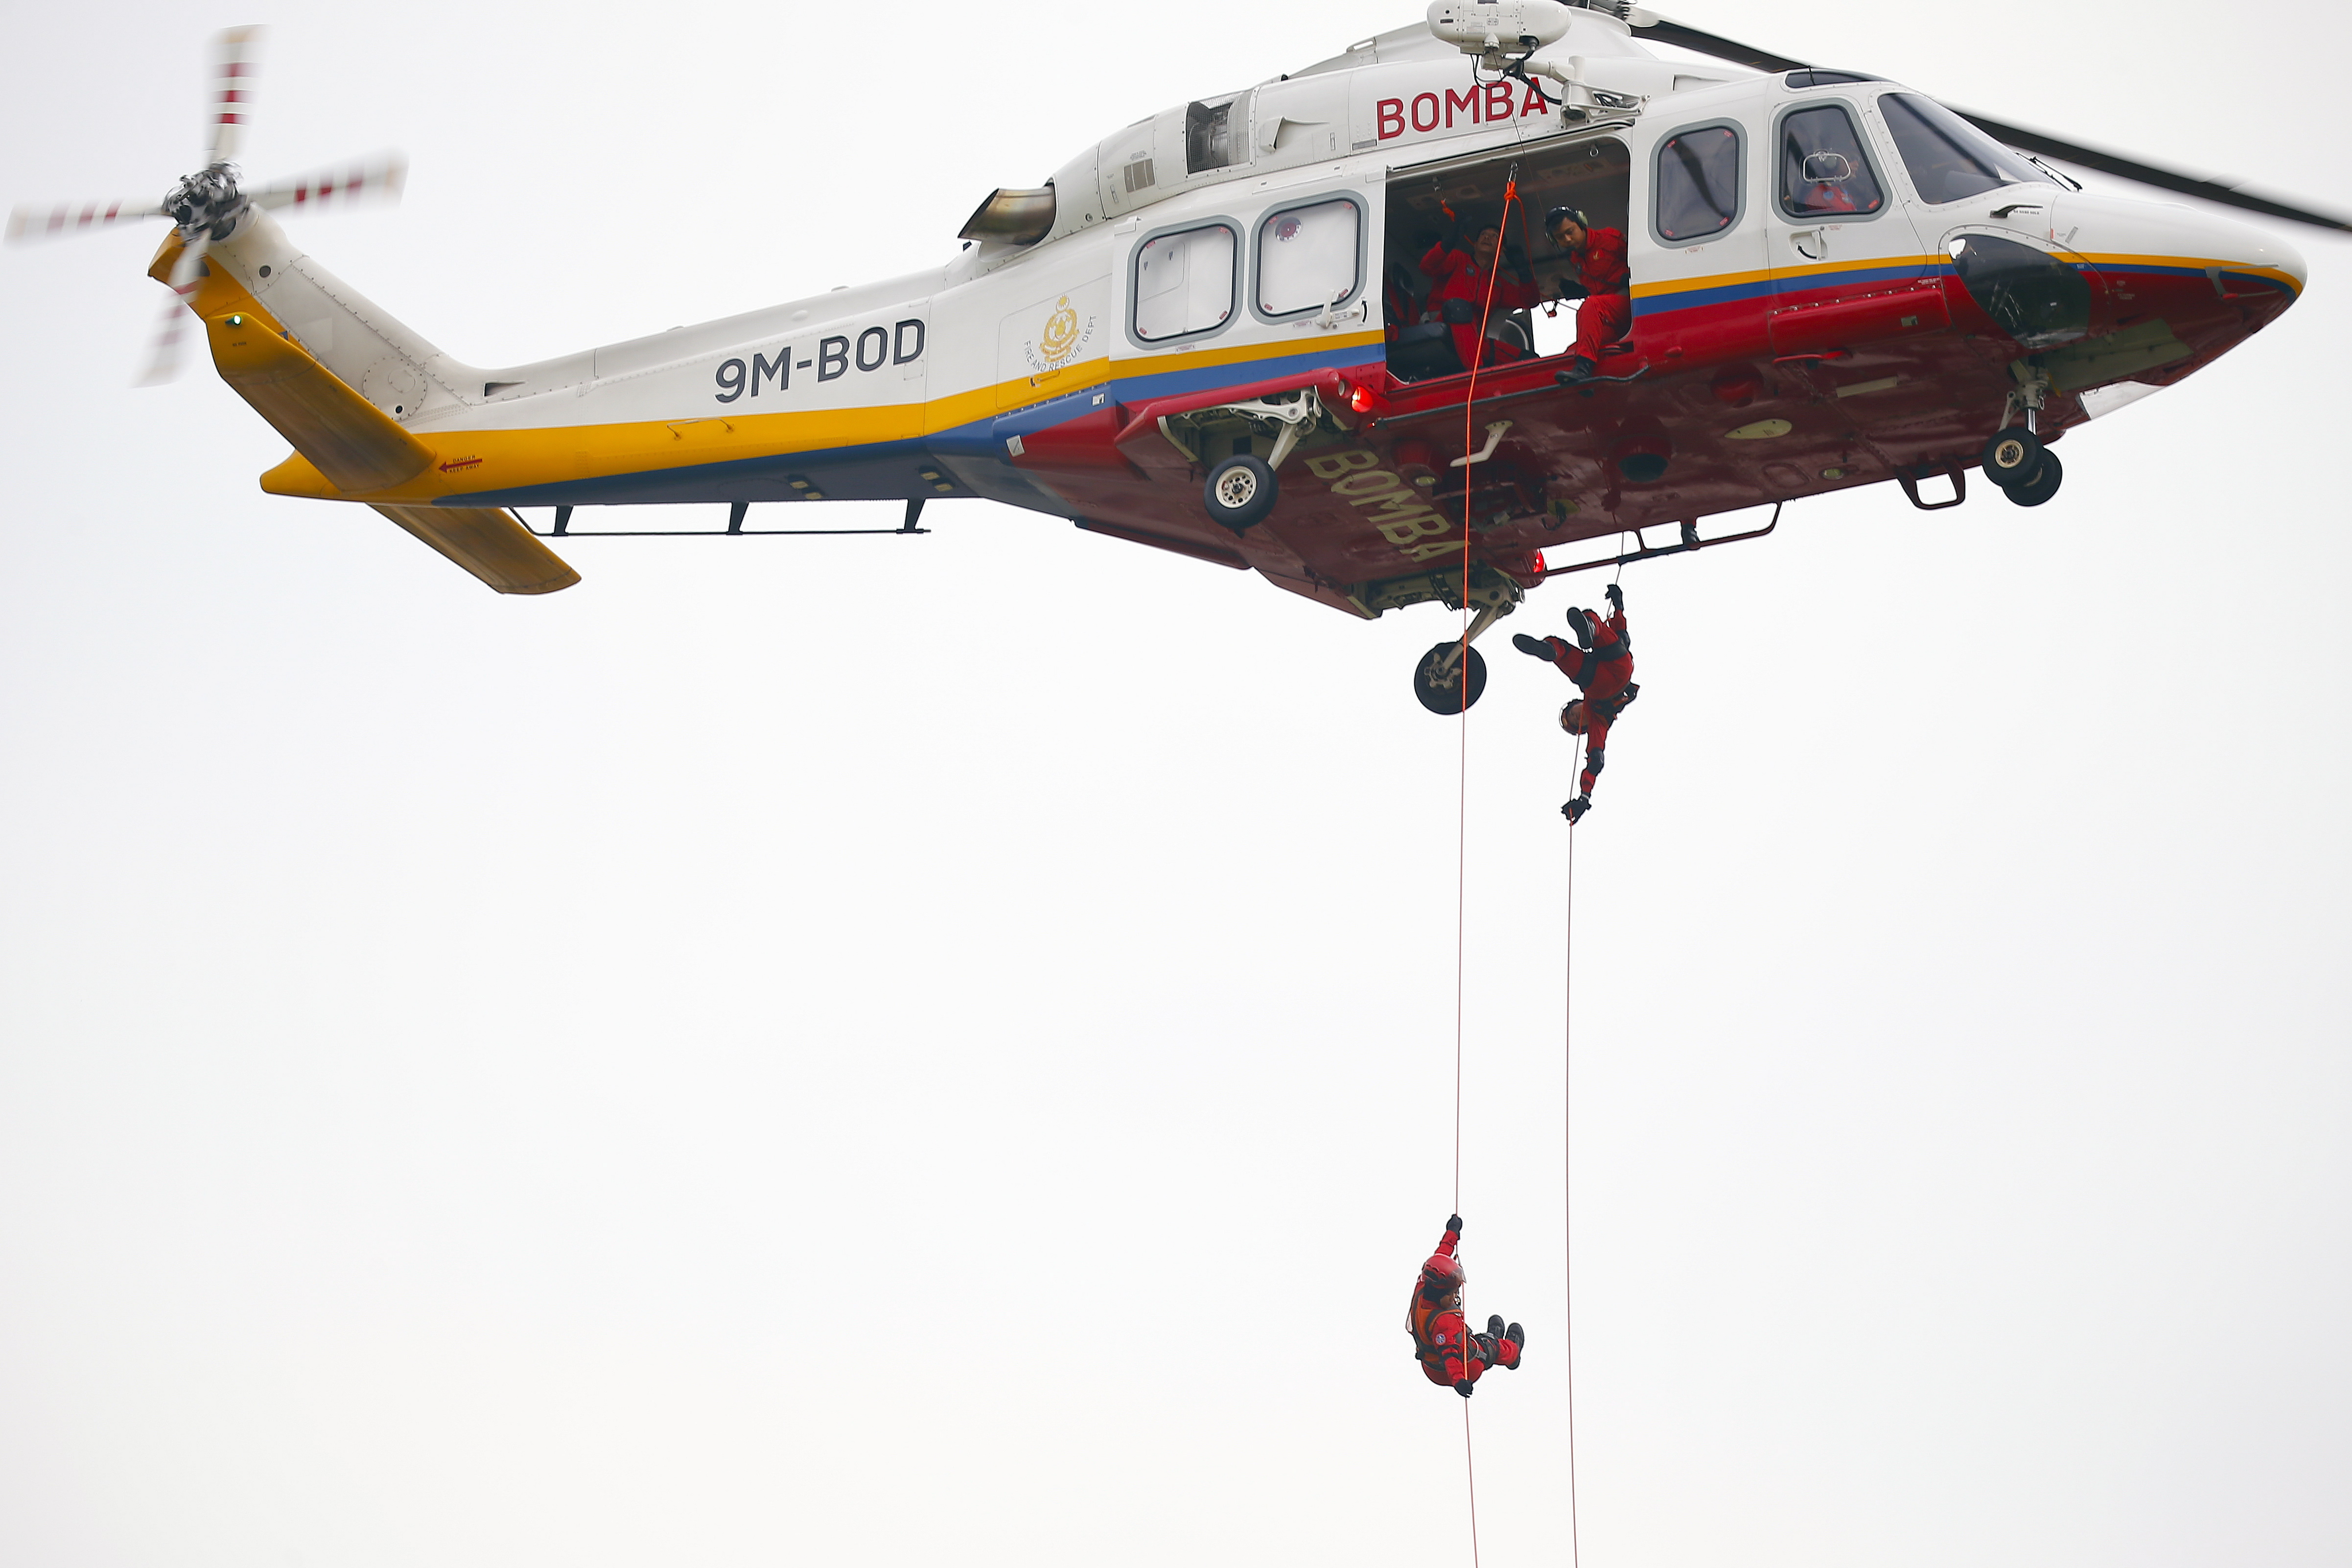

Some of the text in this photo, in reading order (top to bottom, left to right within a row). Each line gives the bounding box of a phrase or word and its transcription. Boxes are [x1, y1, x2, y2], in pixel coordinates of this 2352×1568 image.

[1377, 77, 1548, 140] BOMBA
[715, 319, 925, 403] 9M-BOD
[1024, 340, 1035, 363] FIRE
[1030, 359, 1047, 373] AND
[1048, 343, 1083, 372] RESCUE
[1082, 315, 1096, 343] DEPT
[1303, 450, 1471, 563] BOMBA
